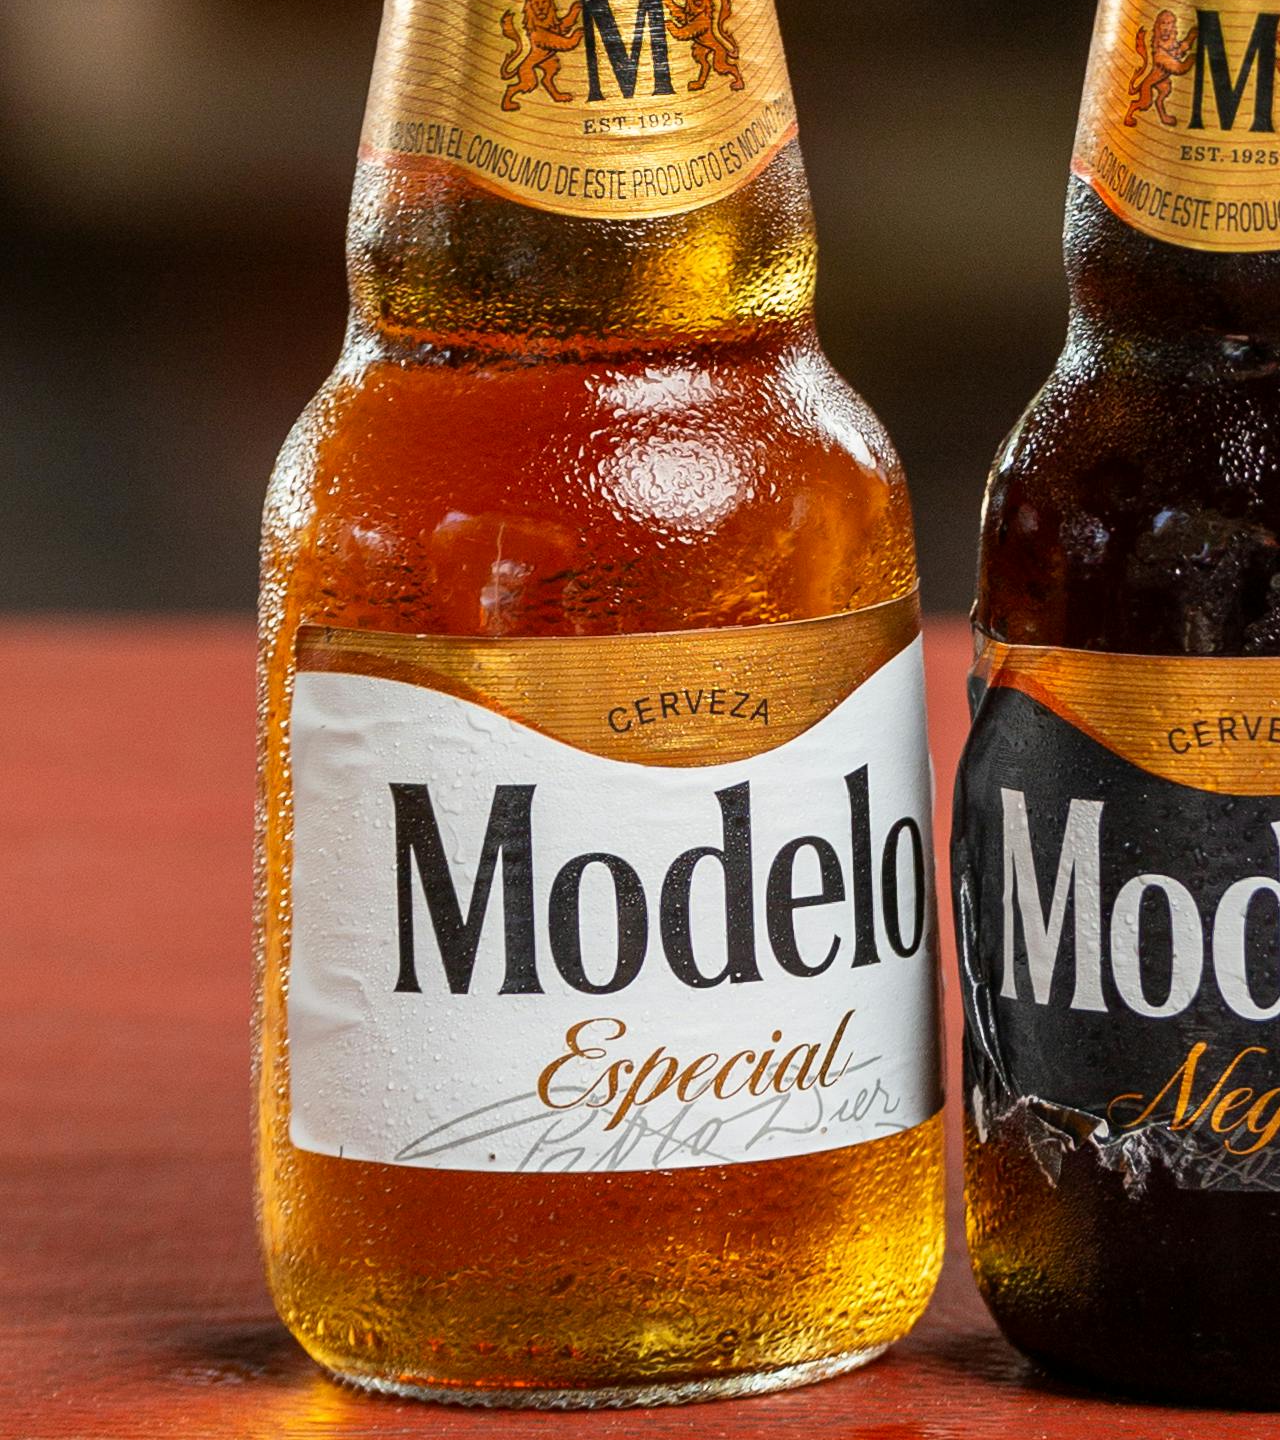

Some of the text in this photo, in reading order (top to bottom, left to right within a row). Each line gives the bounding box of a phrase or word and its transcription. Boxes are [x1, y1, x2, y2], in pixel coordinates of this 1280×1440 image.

[427, 125, 445, 155] EN
[447, 127, 464, 159] EL
[467, 135, 553, 192] CONSUMO
[554, 165, 580, 196] DE
[583, 169, 627, 199] ESTE
[632, 151, 723, 199] PRODUCTO
[719, 142, 743, 174] ES
[738, 106, 778, 162] NOCIVO
[583, 112, 684, 134] EST. 1925
[1180, 146, 1280, 165] EST. 1925
[1097, 145, 1150, 211] CONSUMO
[1149, 188, 1171, 221] DE
[1171, 194, 1211, 230] ESTE
[607, 689, 770, 735] CERVEZA
[389, 763, 925, 996] Modelo
[537, 1009, 855, 1130] Especial
